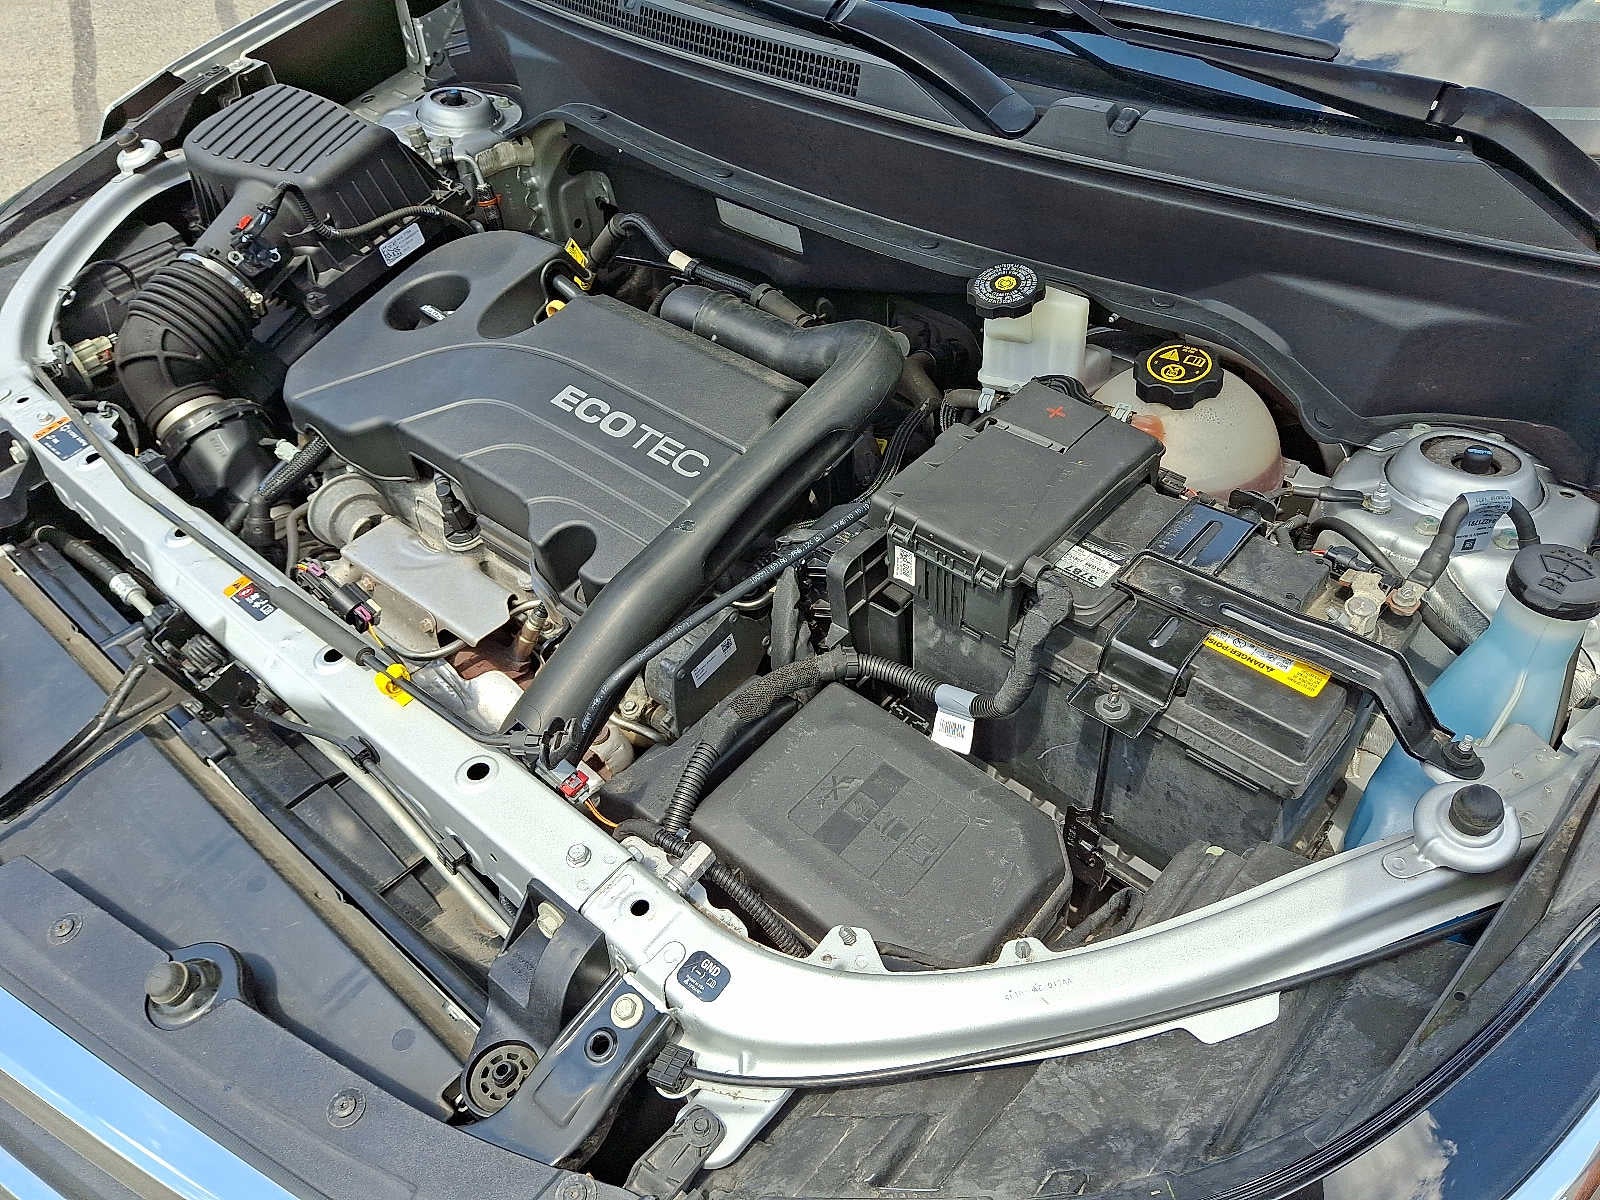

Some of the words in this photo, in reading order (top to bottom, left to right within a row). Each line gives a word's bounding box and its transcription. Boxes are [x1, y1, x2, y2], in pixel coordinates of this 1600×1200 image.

[550, 384, 710, 478] ECOTEC
[1207, 636, 1267, 670] DANGER/POIS
[700, 958, 721, 977] GND
